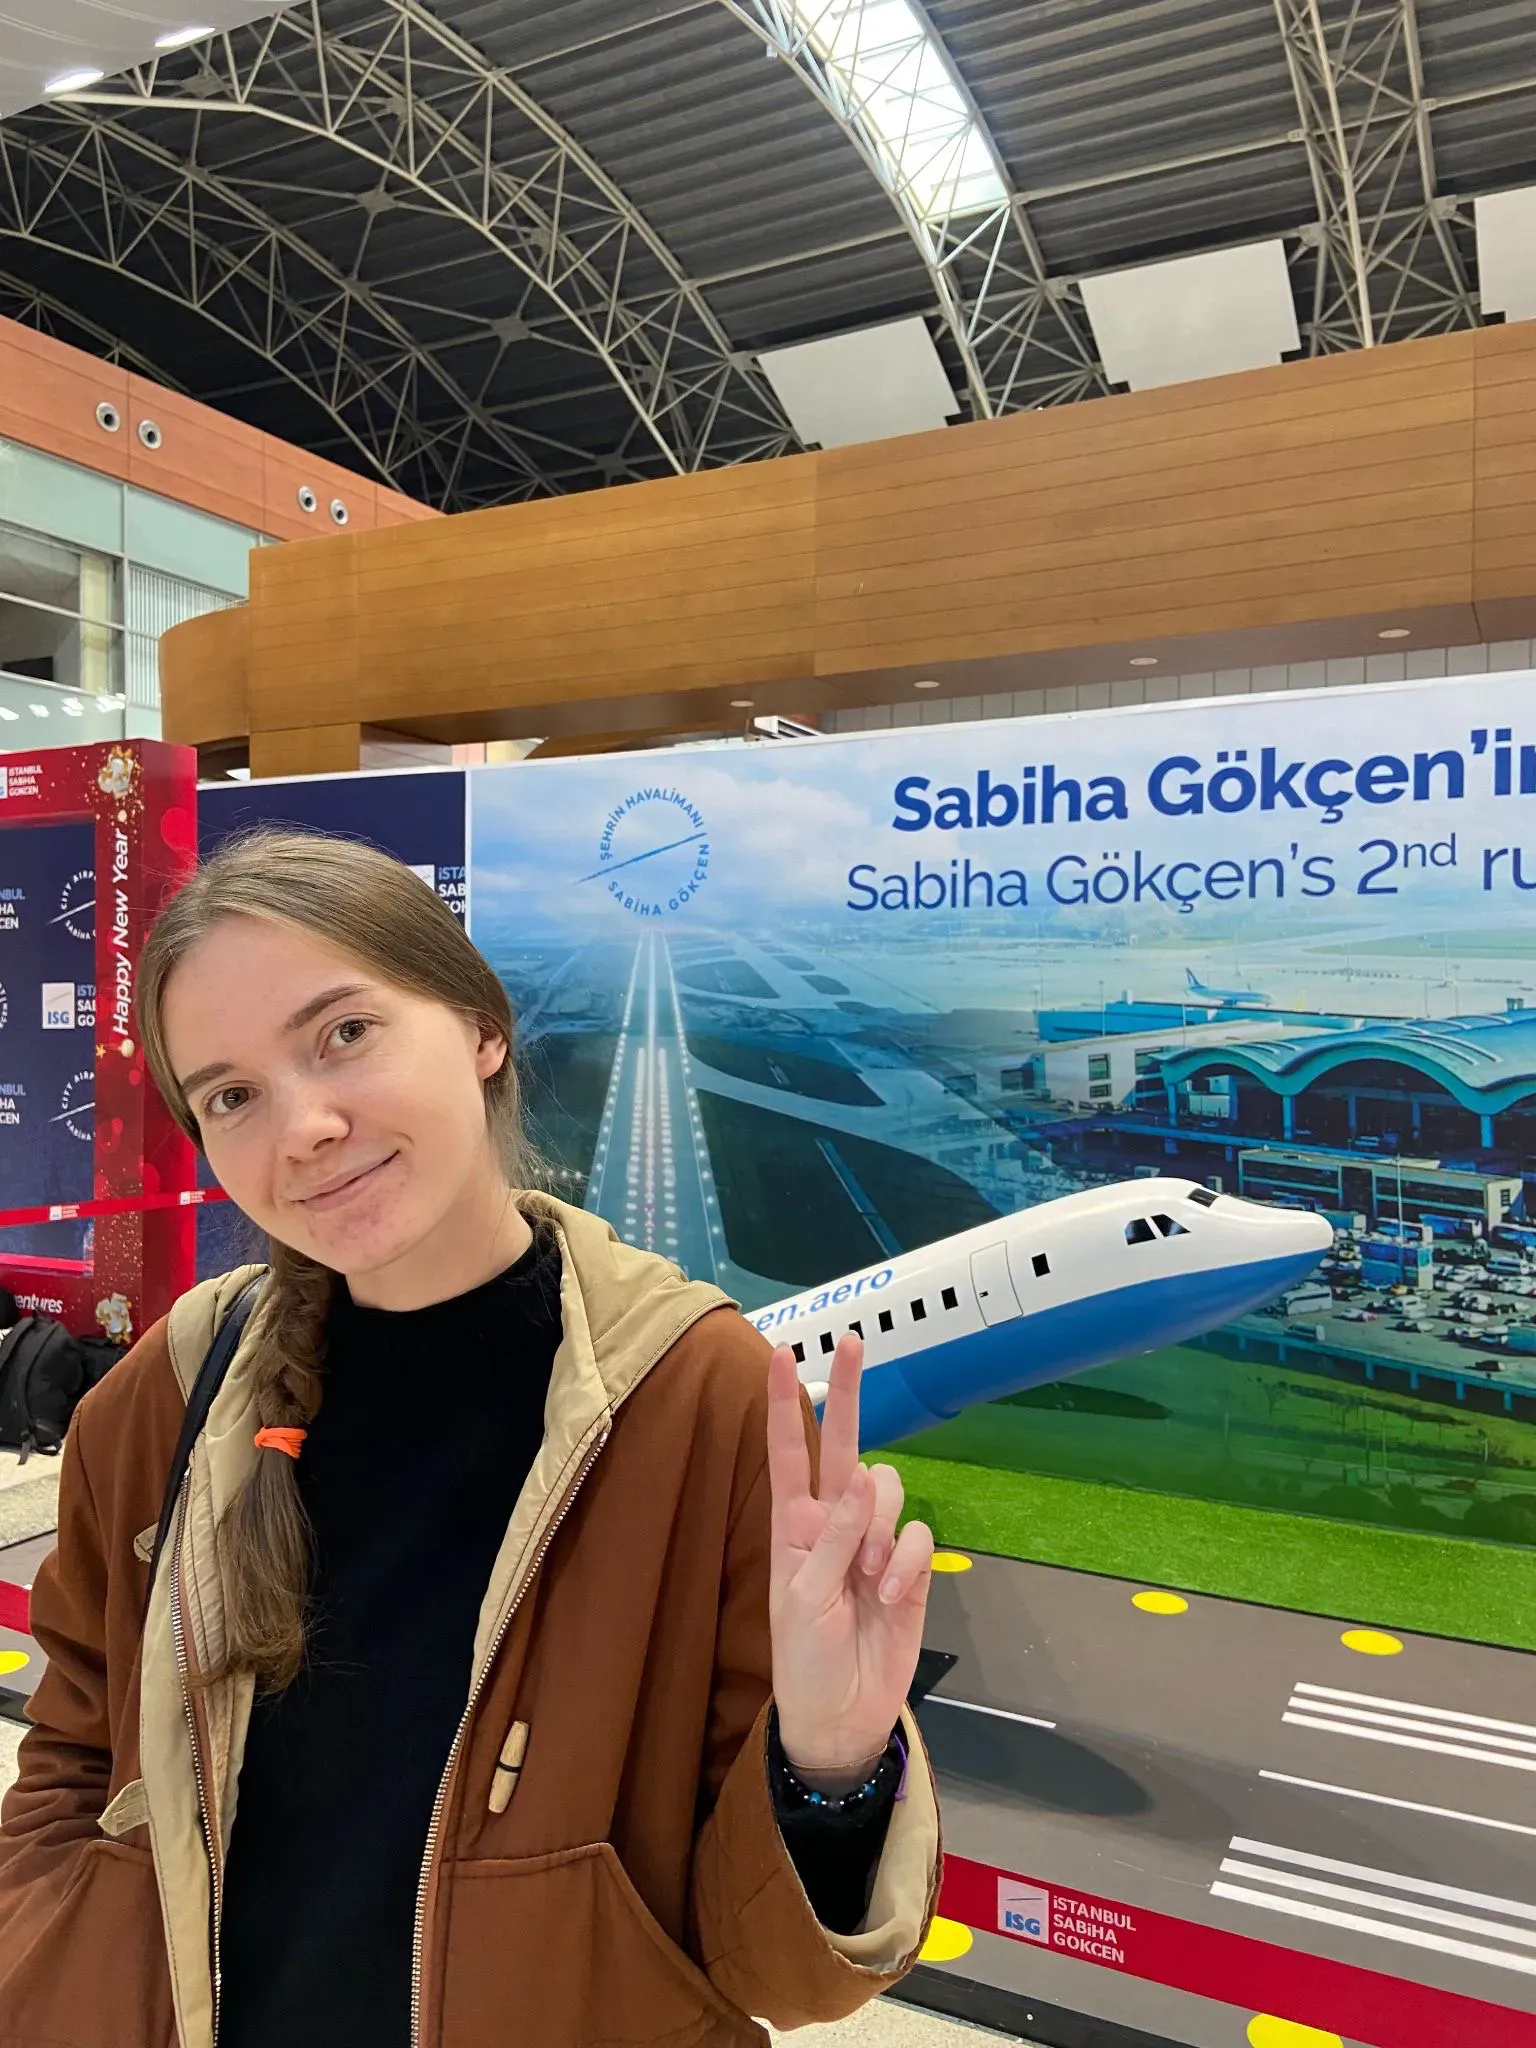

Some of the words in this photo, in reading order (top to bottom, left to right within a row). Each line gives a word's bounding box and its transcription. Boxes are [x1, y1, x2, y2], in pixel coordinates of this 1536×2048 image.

[600, 806, 626, 861] ŞEHRİN
[625, 787, 704, 829] HAVALİMANI
[892, 764, 1129, 832] Sabiha
[112, 828, 129, 884] Year
[668, 844, 710, 911] GÖKÇEN
[846, 858, 1028, 912] Sabiha
[1046, 843, 1336, 914] Gökçen’s
[1357, 832, 1458, 895] 2nd
[113, 889, 129, 949] New
[47, 1010, 70, 1025] ISG
[113, 951, 132, 1036] Happy
[14, 1293, 64, 1314] entures
[751, 1268, 894, 1333] en.aero
[1005, 1910, 1041, 1936] ISG
[1053, 1931, 1125, 1964] GOKCEN
